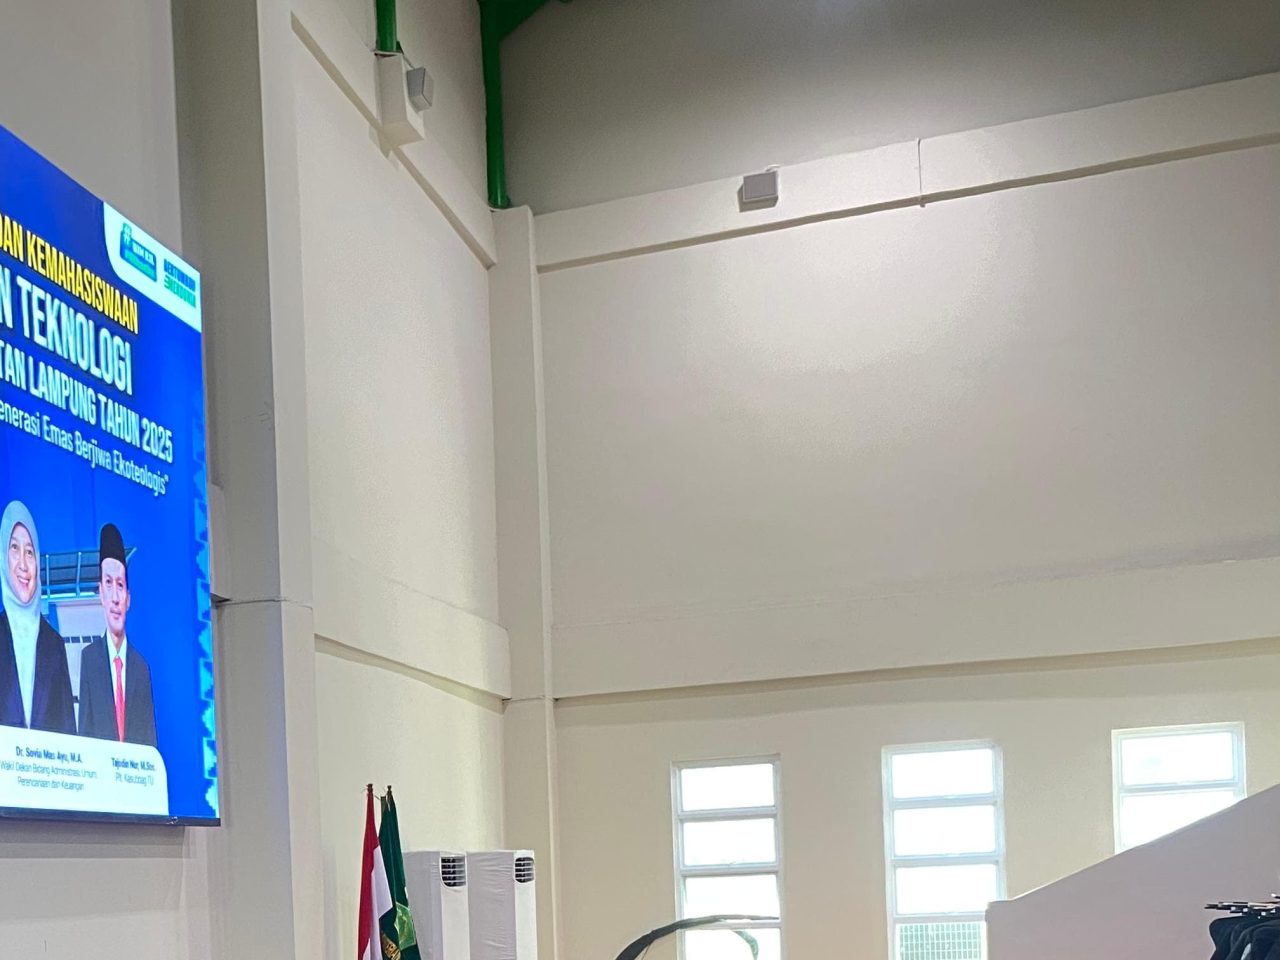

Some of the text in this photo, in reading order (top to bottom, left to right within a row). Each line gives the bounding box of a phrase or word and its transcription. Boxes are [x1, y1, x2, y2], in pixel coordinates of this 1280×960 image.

[27, 230, 138, 334] KEMAHASISWAAN
[16, 275, 132, 396] TEKNOLOGI
[29, 355, 96, 425] LAMPUNG
[98, 393, 140, 448] TAHUN
[142, 418, 173, 463] 2025
[43, 414, 74, 451] Emas
[75, 430, 112, 470] Berjiwa
